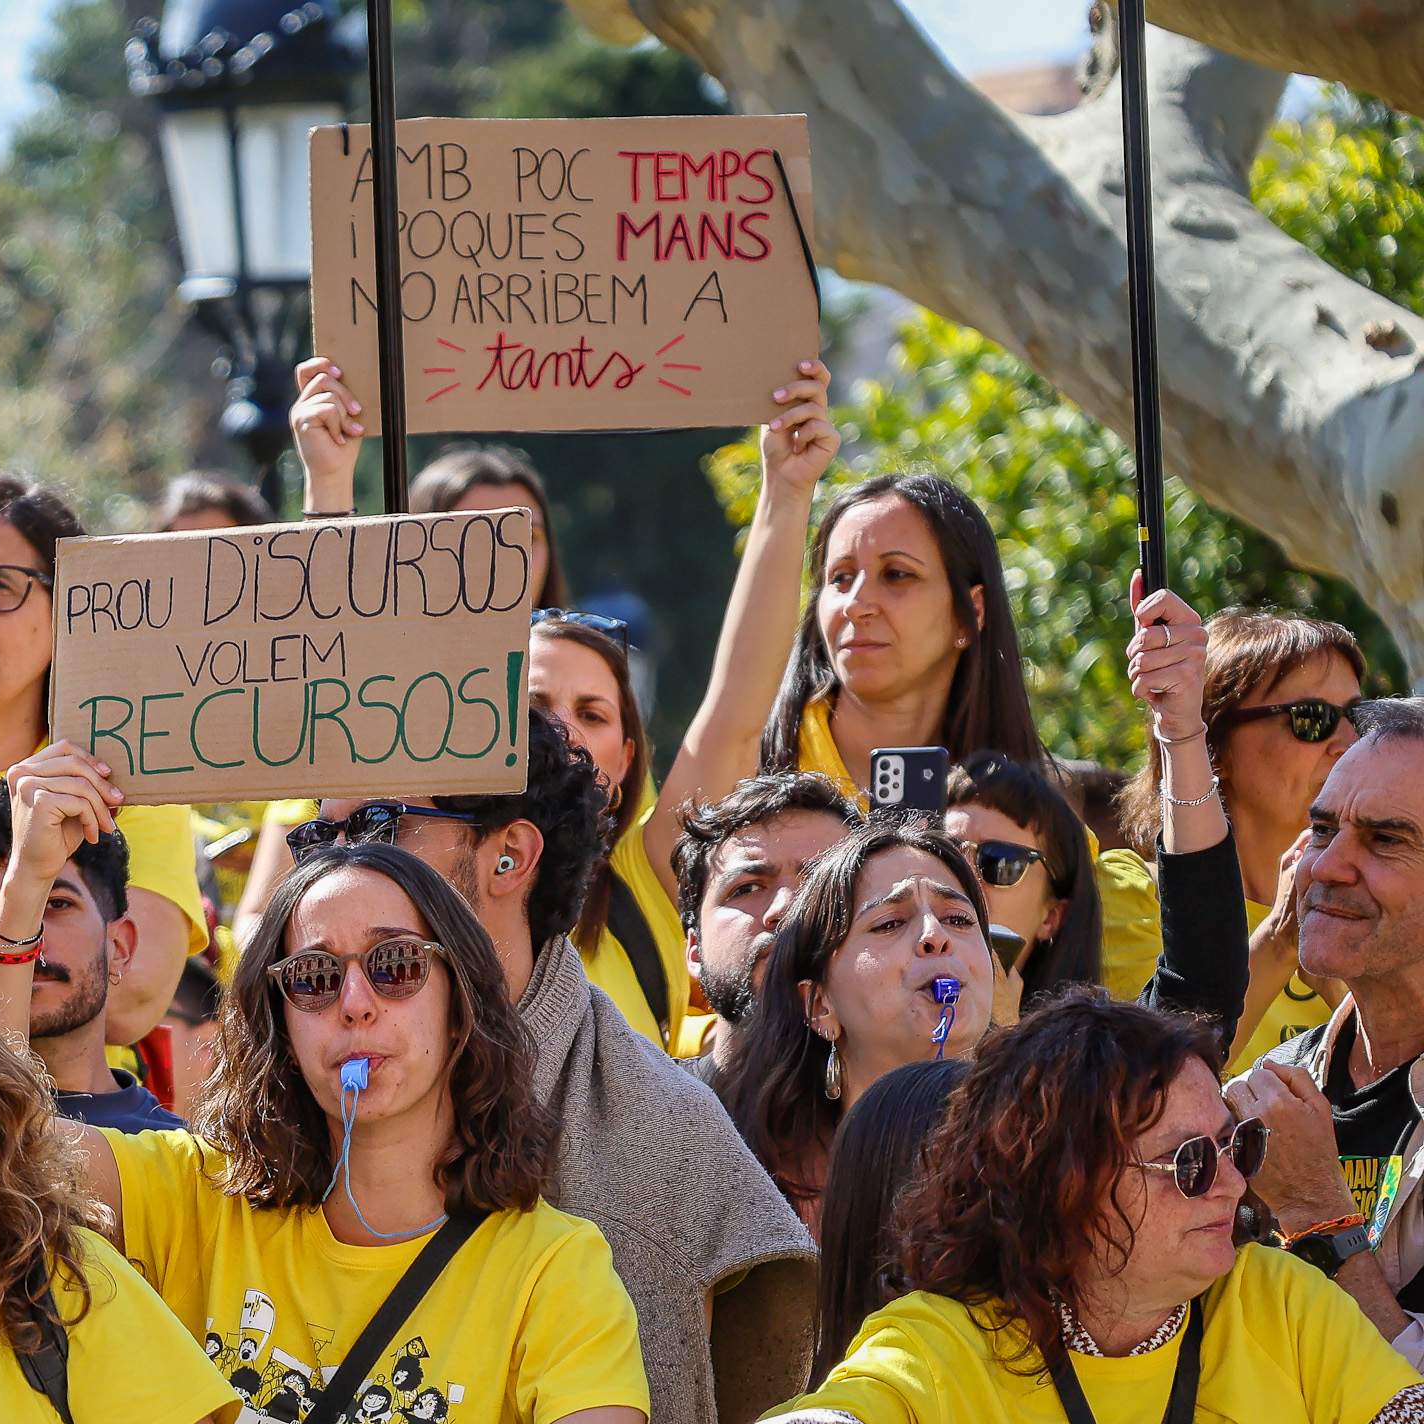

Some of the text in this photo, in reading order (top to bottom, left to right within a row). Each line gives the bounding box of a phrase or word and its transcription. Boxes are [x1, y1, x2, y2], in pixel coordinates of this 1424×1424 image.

[512, 147, 593, 203] POC
[617, 148, 775, 205] TEMPS
[615, 210, 773, 262] MANS
[684, 270, 728, 323] A
[477, 332, 648, 391] tants
[67, 576, 174, 634] PROU
[175, 631, 348, 687] VOLEM
[78, 651, 525, 776] RECURSOS!
